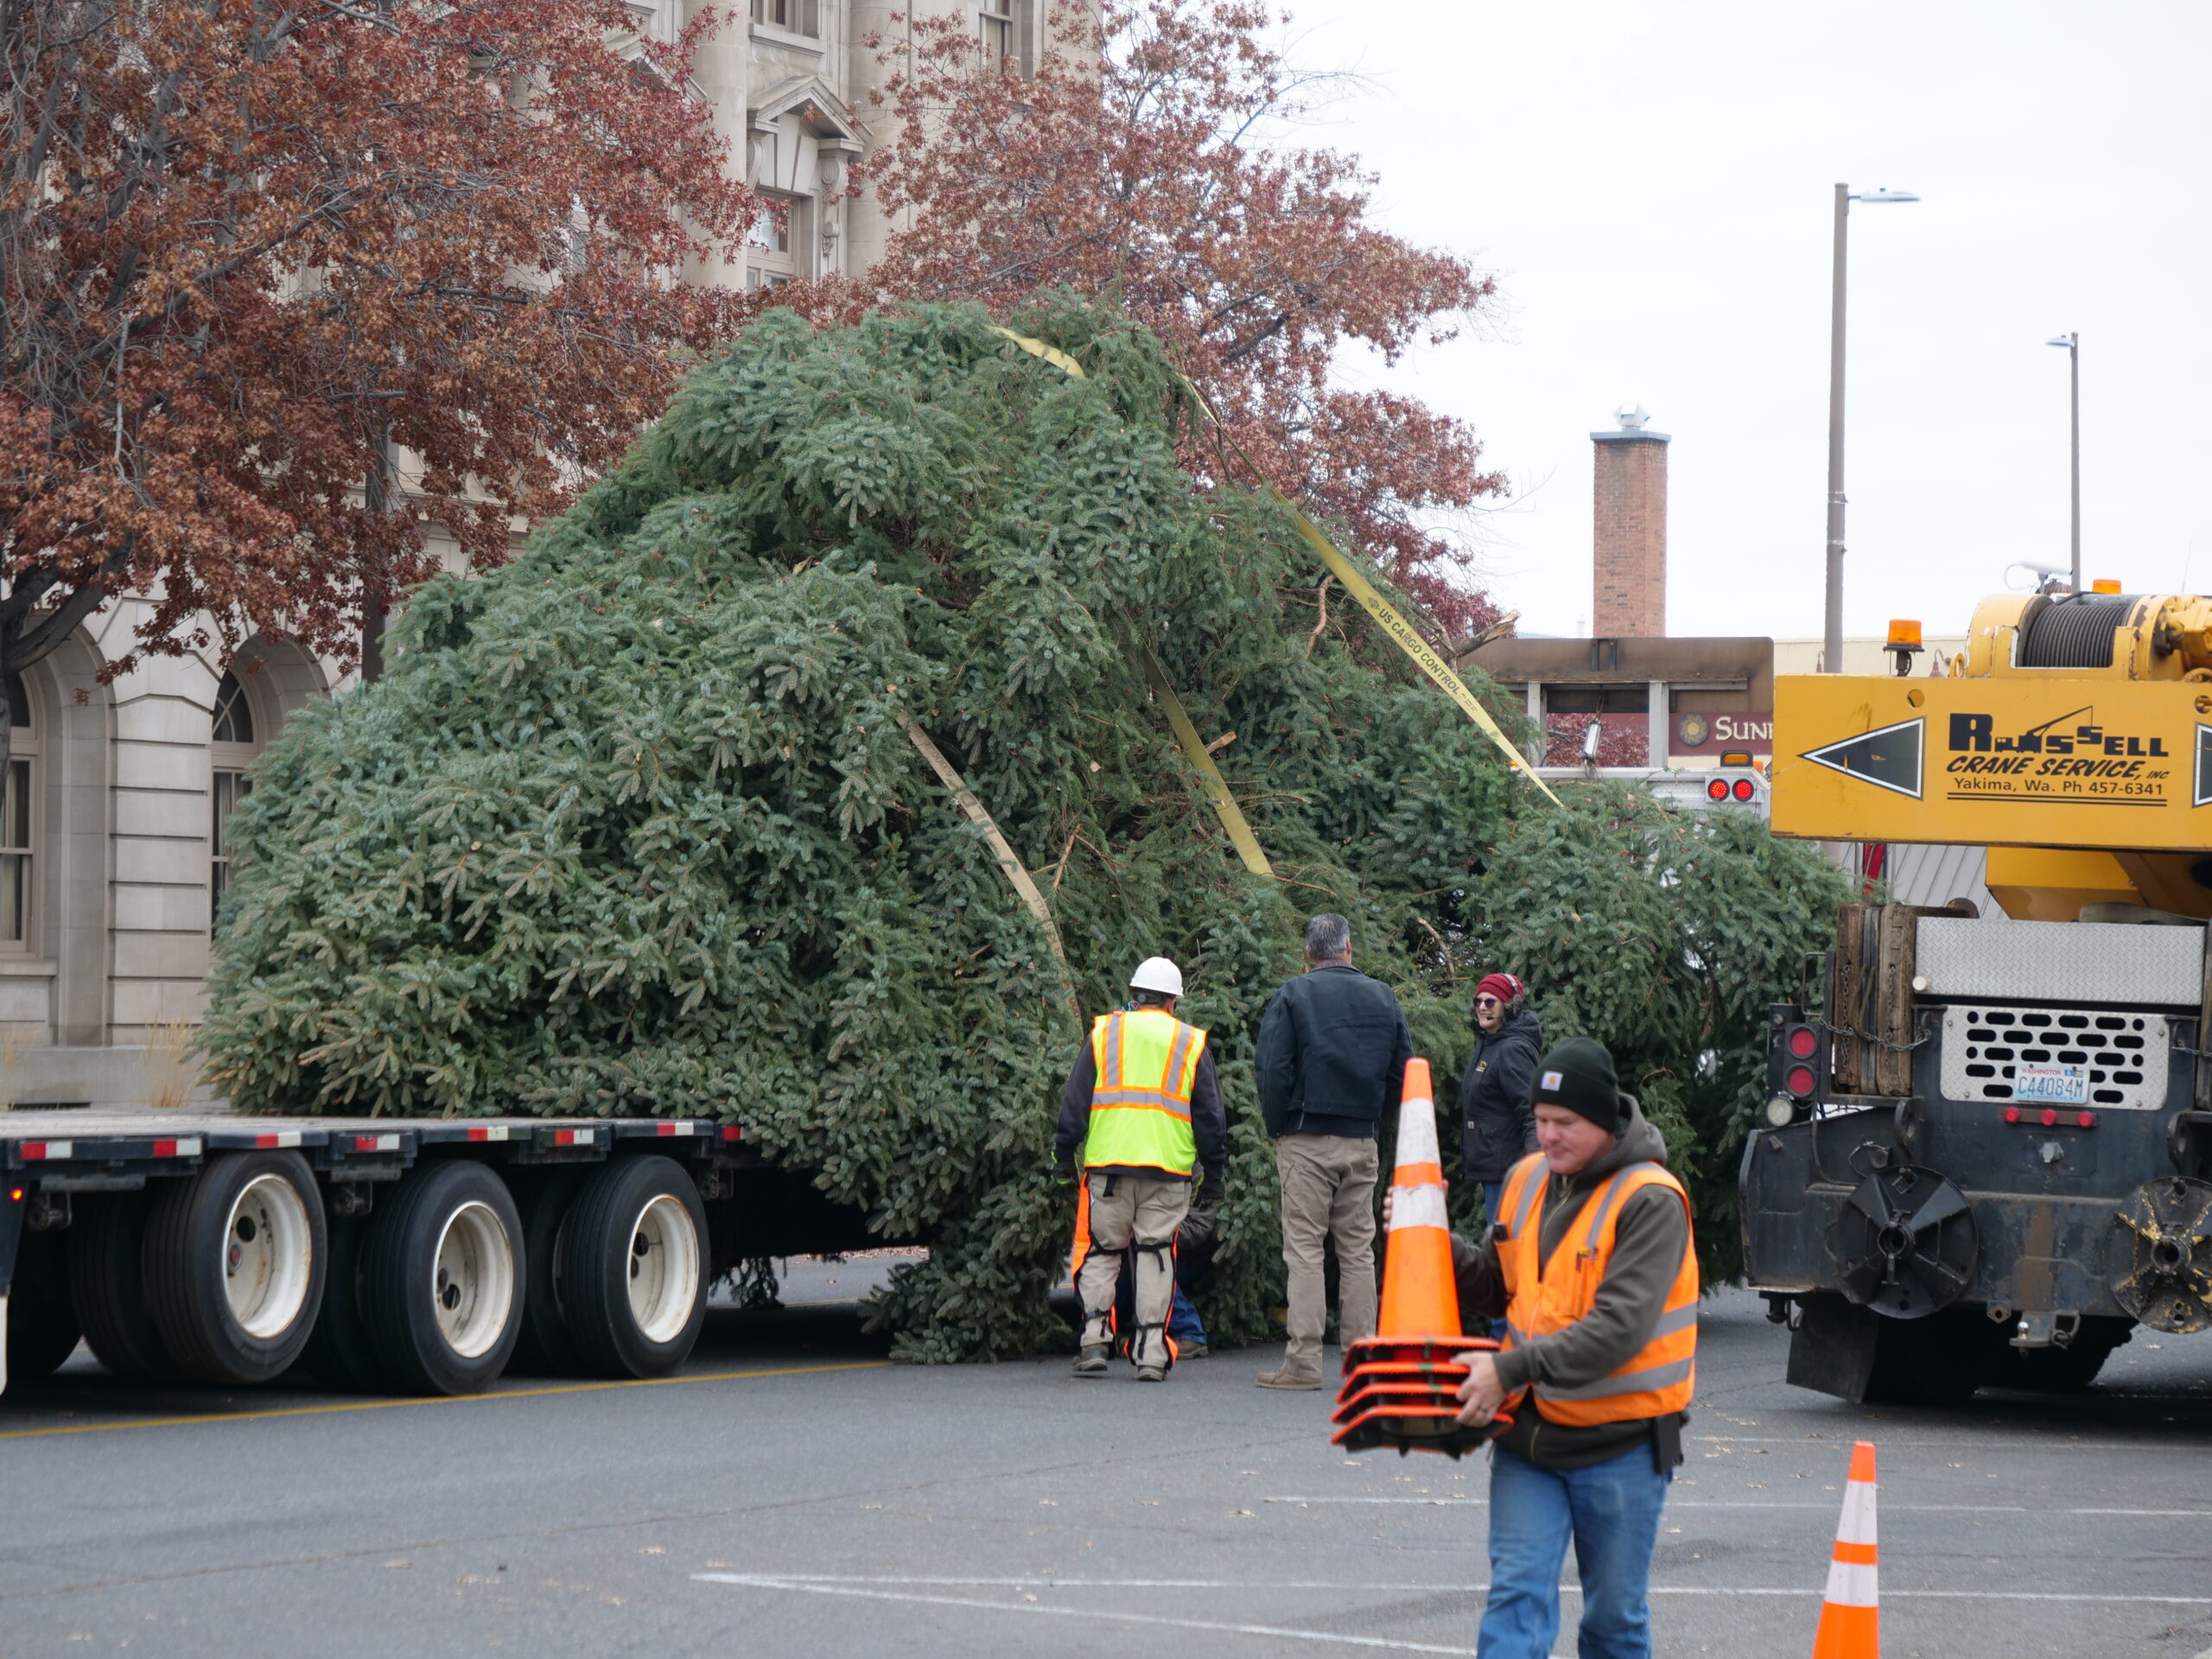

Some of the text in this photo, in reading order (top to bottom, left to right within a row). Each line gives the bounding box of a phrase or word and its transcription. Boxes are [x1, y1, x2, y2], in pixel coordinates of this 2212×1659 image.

[1379, 608, 1461, 695] US CARGO CONTROL
[1948, 713, 2169, 758] RUSSELL
[1946, 755, 2171, 781] CRANE SERVICE, INC
[1954, 777, 2163, 796] Yakima, Wa. Ph 457-6341
[2018, 1076, 2083, 1098] C44084M
